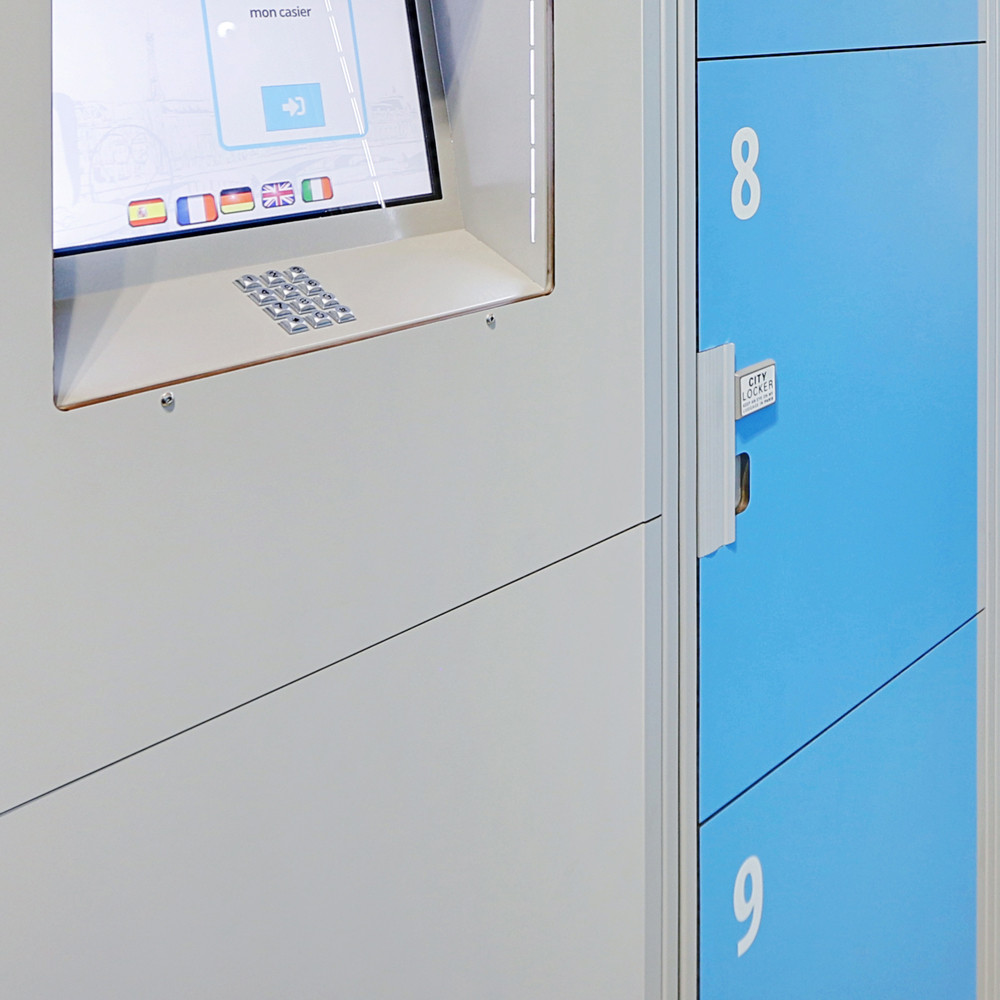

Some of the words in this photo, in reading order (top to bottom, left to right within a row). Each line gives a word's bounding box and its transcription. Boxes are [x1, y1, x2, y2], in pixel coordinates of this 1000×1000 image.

[250, 8, 277, 18] mon
[279, 5, 312, 18] casier
[731, 126, 761, 220] 8
[748, 372, 767, 387] CITY
[742, 380, 774, 402] LOCKER
[733, 855, 763, 958] 9
